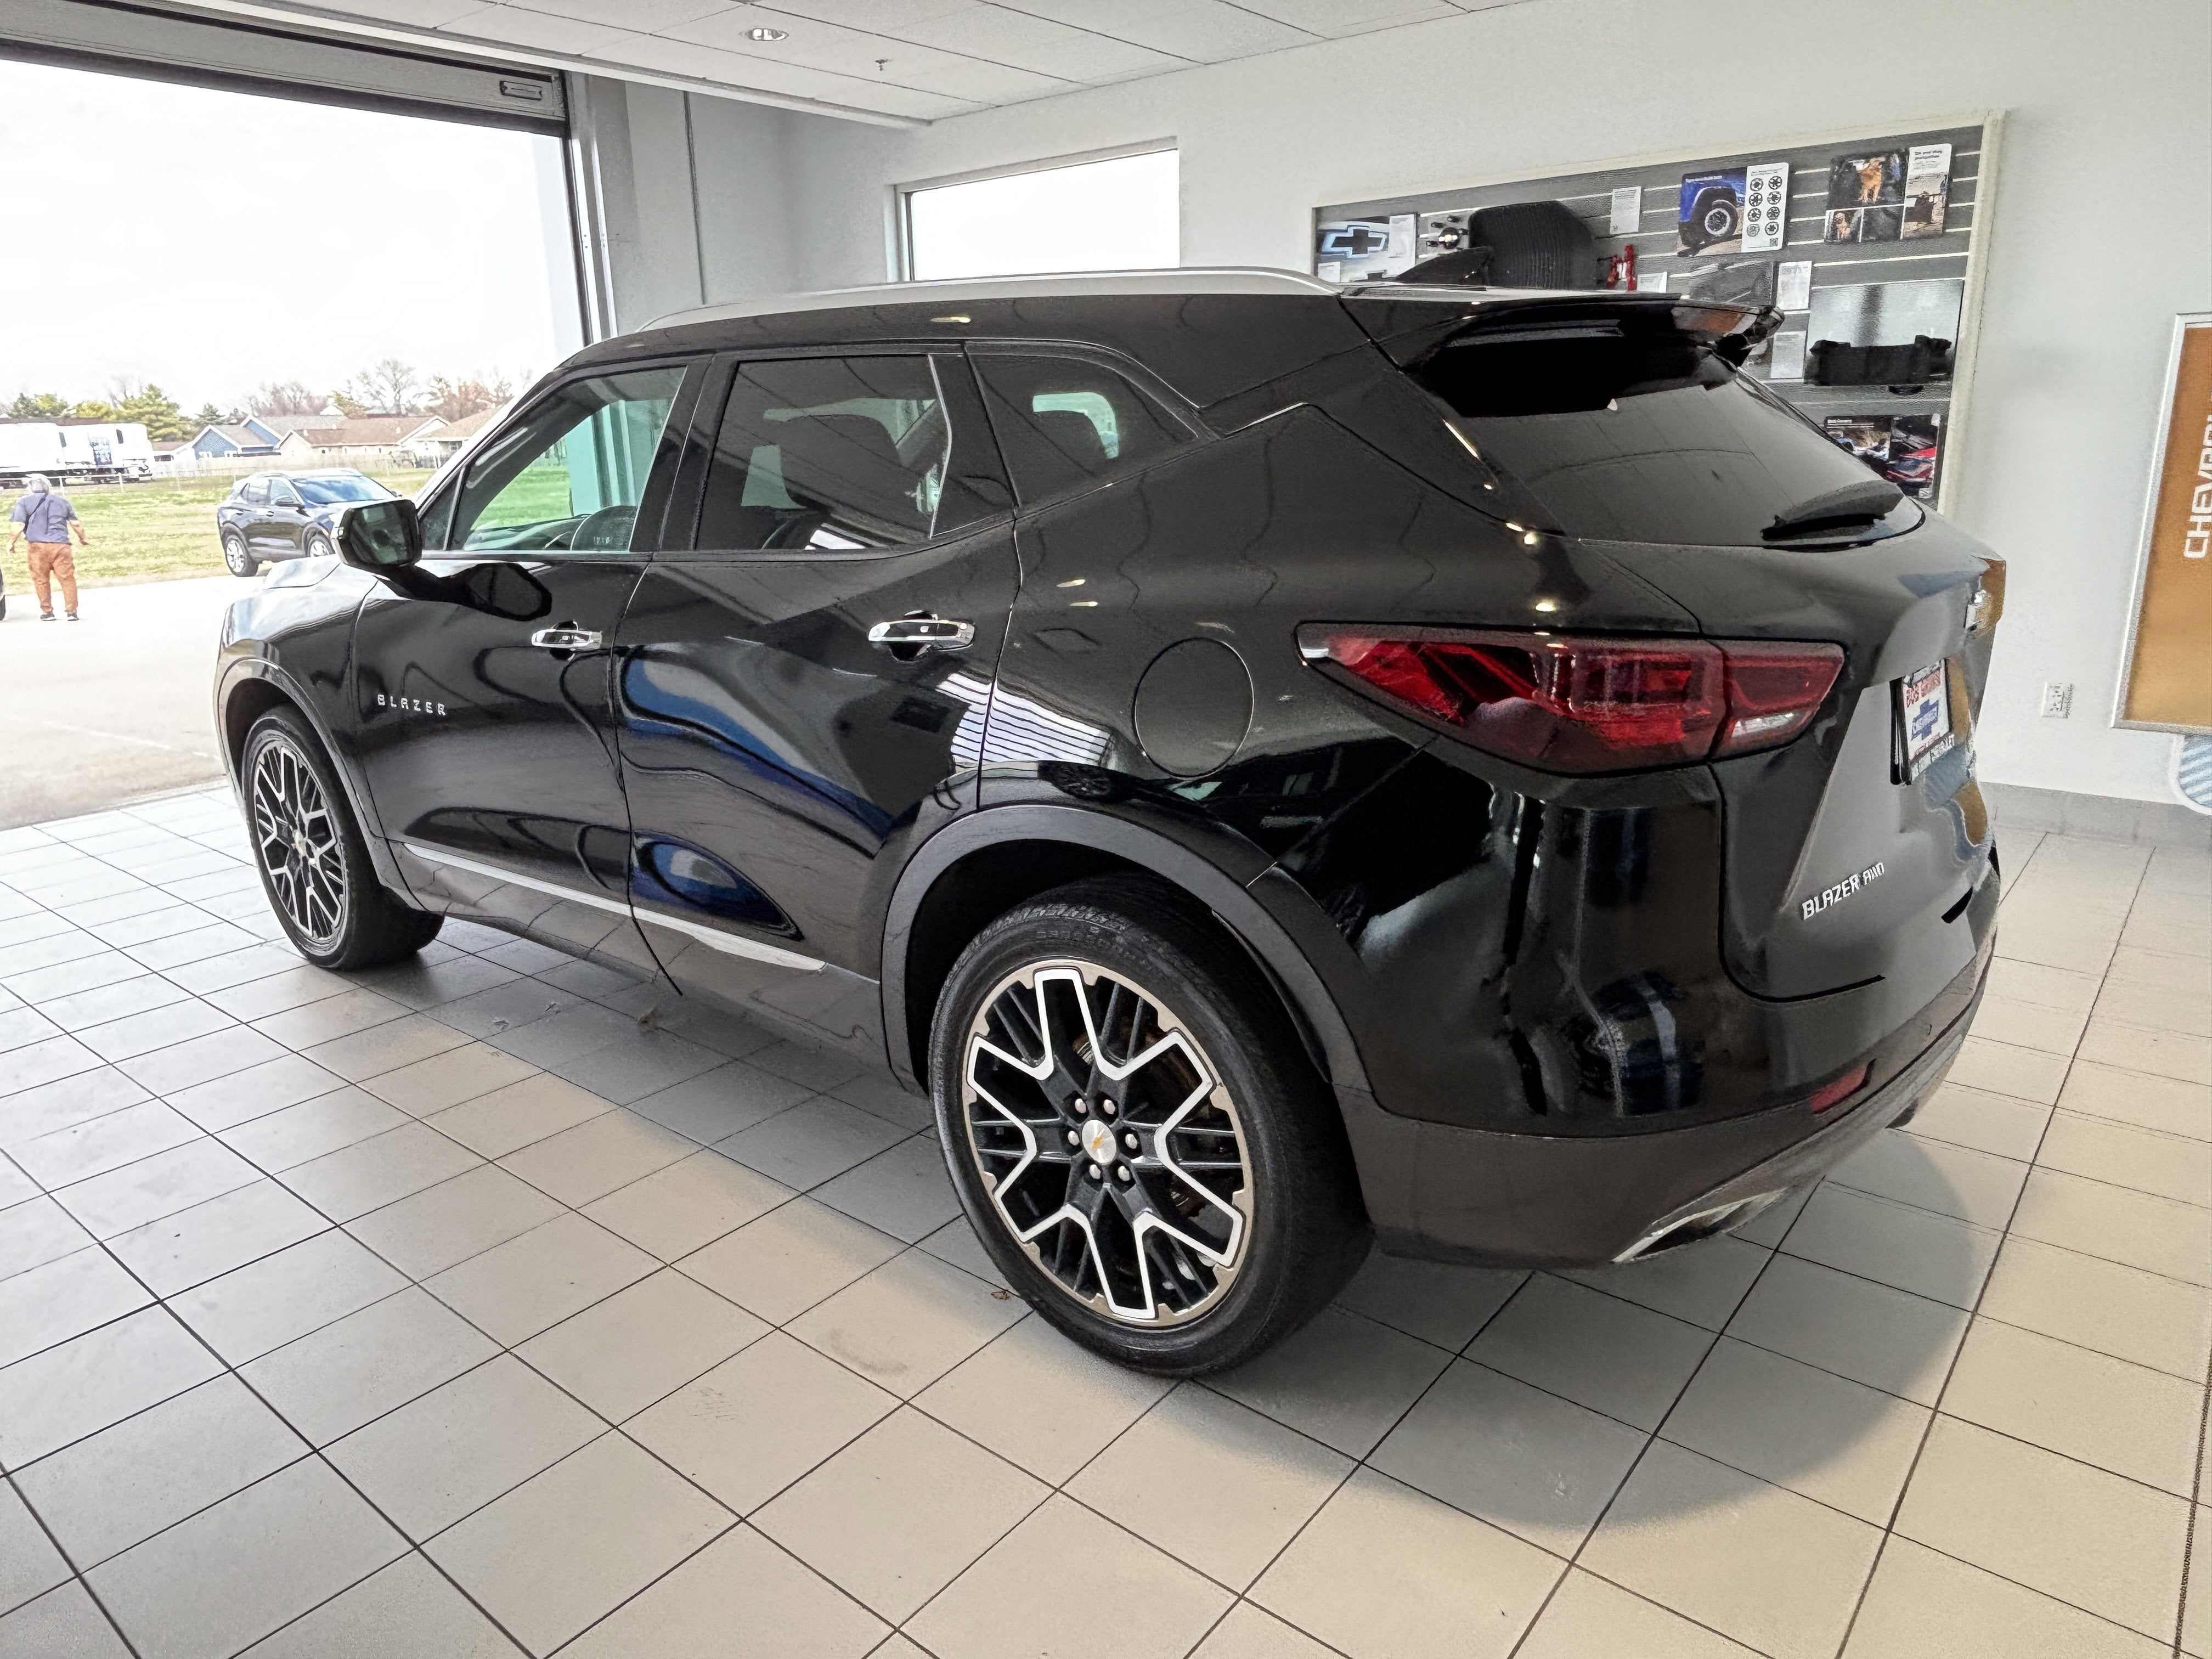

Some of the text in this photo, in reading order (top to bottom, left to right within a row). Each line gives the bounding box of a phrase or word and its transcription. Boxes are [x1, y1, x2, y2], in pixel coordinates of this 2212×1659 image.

[2183, 388, 2212, 558] CHEVR
[377, 693, 446, 716] BLAZER
[1802, 873, 1860, 921] BLAZER
